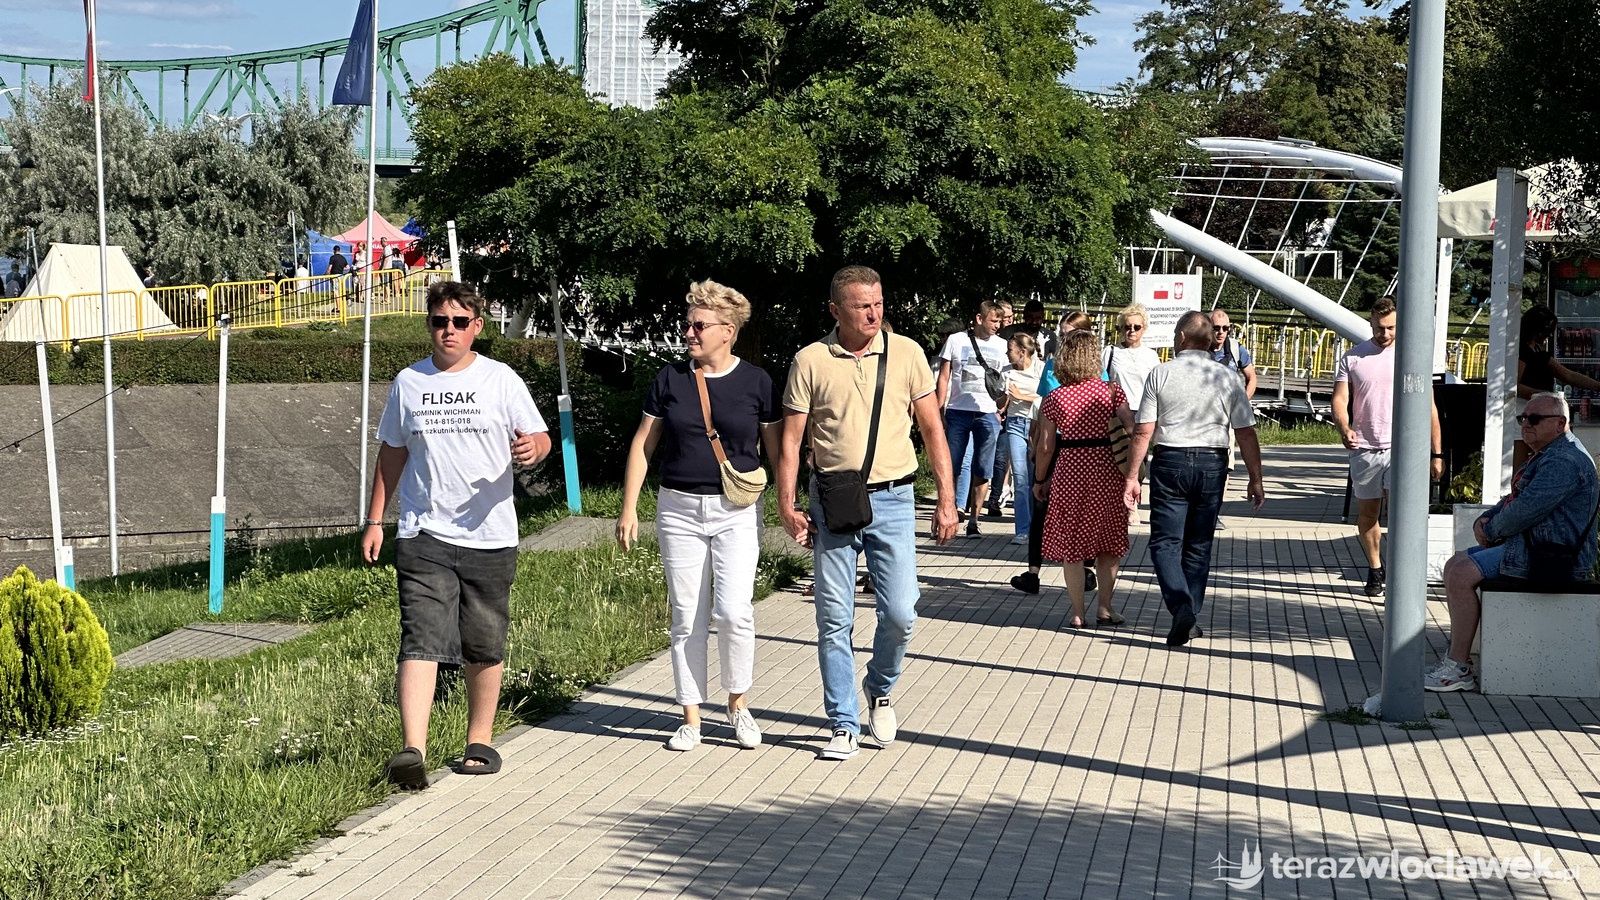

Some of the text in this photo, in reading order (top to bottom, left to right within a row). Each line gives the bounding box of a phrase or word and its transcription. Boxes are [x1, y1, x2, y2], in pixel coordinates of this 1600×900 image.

[422, 391, 476, 405] FLISAK
[412, 408, 481, 417] DOMINIK WICHMAN
